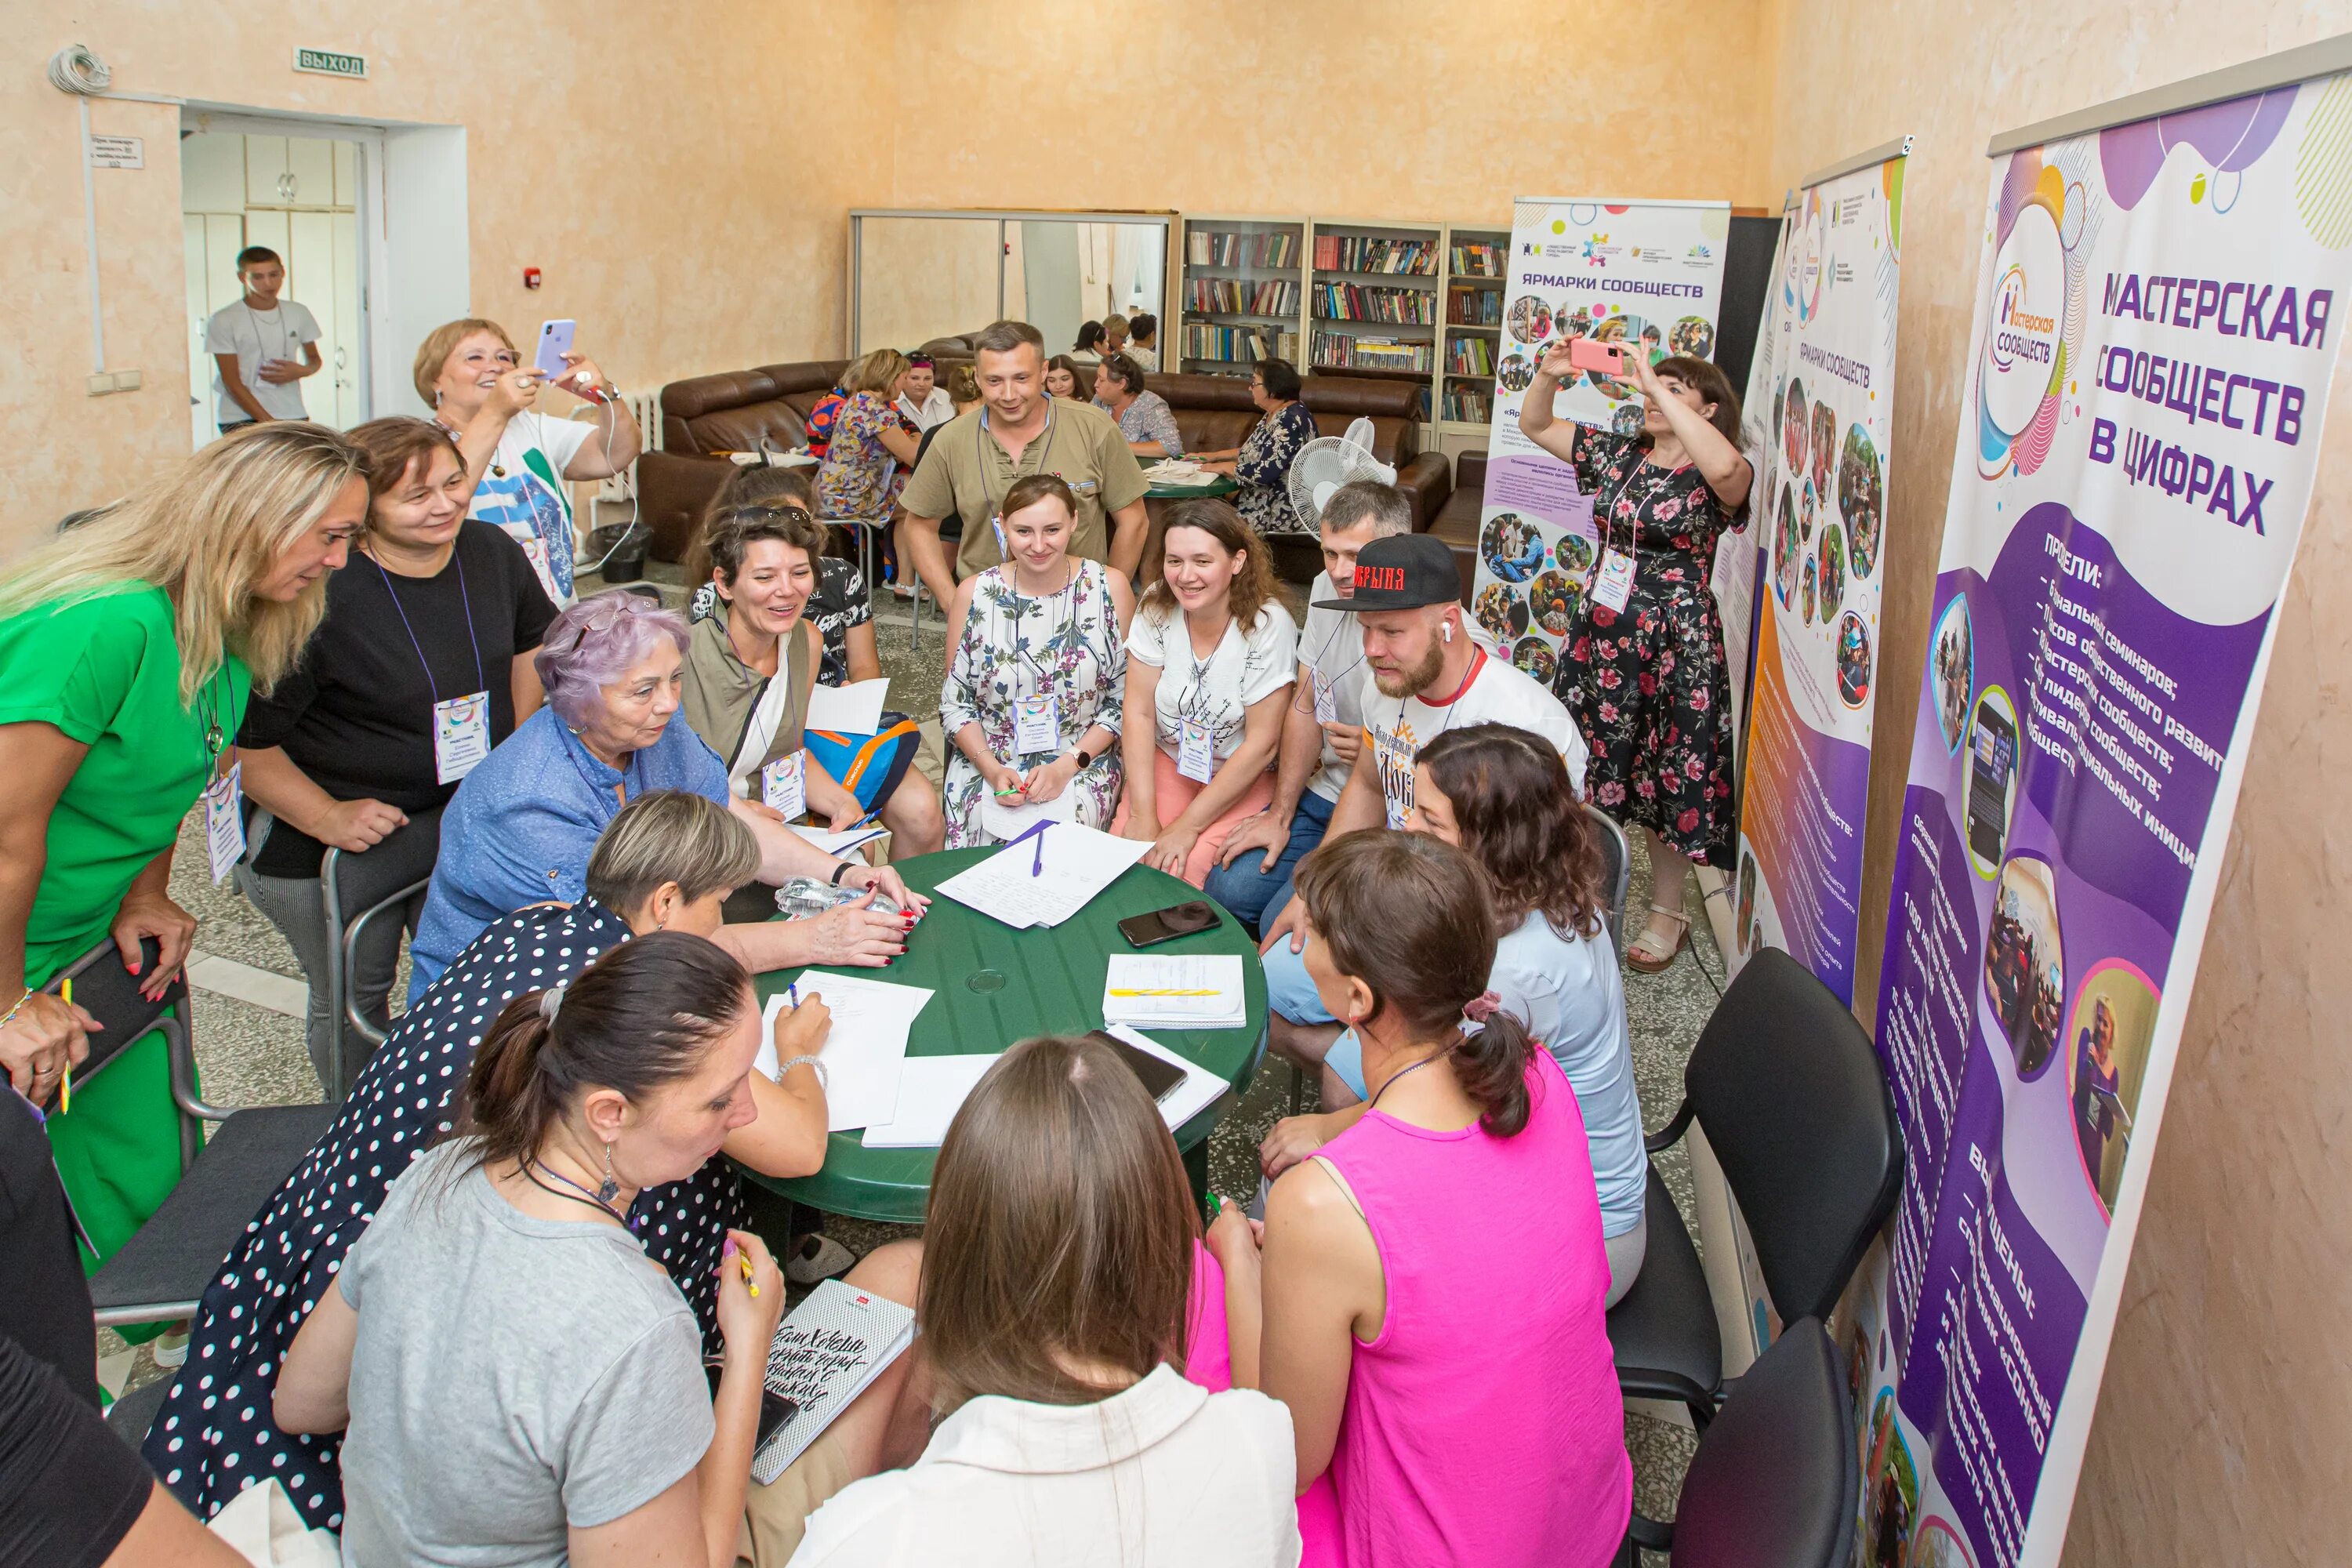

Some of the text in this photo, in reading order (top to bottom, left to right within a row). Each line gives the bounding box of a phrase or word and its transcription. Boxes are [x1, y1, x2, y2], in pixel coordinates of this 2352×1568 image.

[301, 51, 361, 74] ВЫХОД
[1523, 274, 1704, 298] ЯРМАРКИ СООБЩЕСТВ
[2001, 283, 2054, 336] Мастерская
[2103, 272, 2333, 350] МАСТЕРСКАЯ
[1800, 343, 1870, 389] ЯРМАРКИ СООБЩЕСТВ
[1998, 332, 2050, 365] СООБЩЕСТВ
[2096, 345, 2307, 446] СООБЩЕСТВ
[2089, 419, 2275, 537] В ЦИФРАХ
[2105, 630, 2178, 701] семинаров;
[2090, 720, 2162, 802] сообществ;
[2099, 695, 2174, 775] сообществ;
